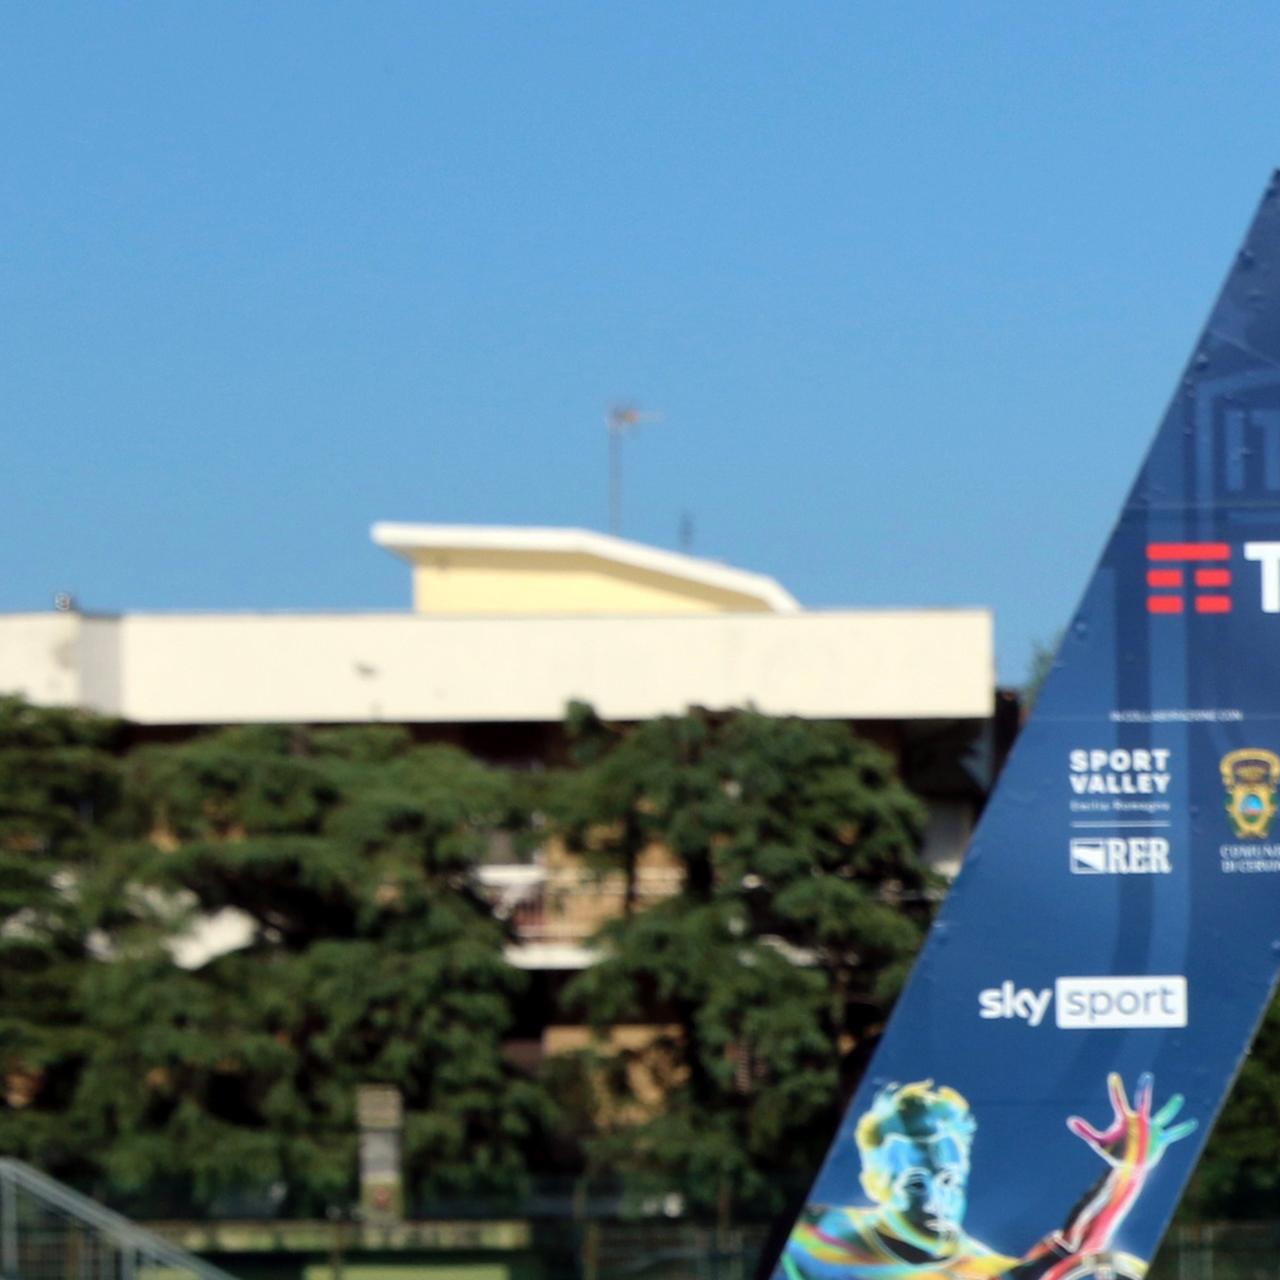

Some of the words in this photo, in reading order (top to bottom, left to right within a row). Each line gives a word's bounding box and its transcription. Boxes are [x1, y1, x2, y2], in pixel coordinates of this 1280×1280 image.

[1070, 749, 1170, 772] SPORT
[1069, 773, 1171, 794] VALLEY
[1106, 837, 1172, 874] RER
[978, 980, 1053, 1027] sky
[1067, 985, 1176, 1021] sport
